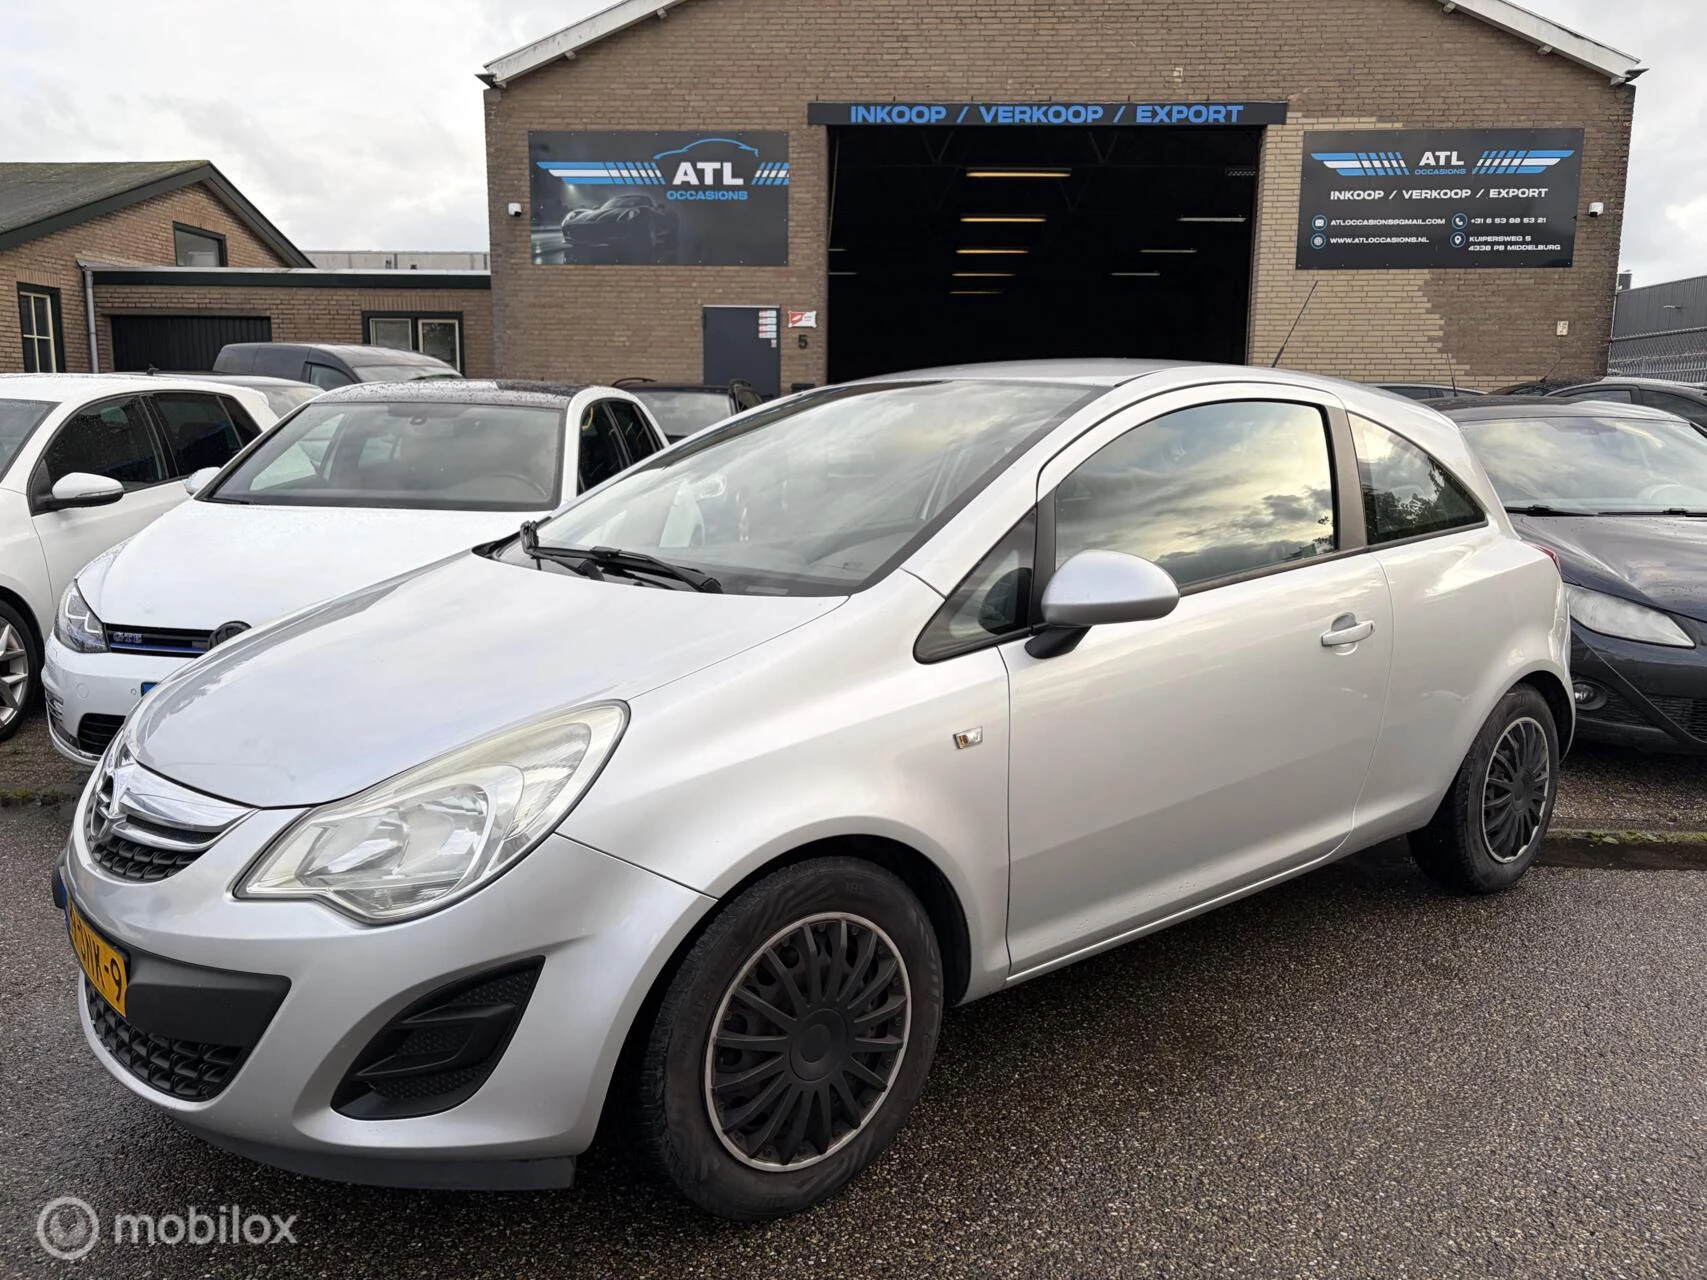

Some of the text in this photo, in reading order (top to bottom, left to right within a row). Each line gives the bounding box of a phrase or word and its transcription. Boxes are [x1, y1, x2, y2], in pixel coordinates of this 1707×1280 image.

[849, 105, 1244, 124] INKOOP / VERKOOP / EXPORT
[1418, 151, 1464, 166] ATL
[672, 162, 744, 185] ATL
[666, 190, 749, 200] OCCASIONS
[1330, 188, 1549, 200] INKOOP / VERKOOP / EXPORT
[1330, 218, 1445, 226] ATLOCCASIONS@GMAIL.COM
[798, 334, 808, 350] 5
